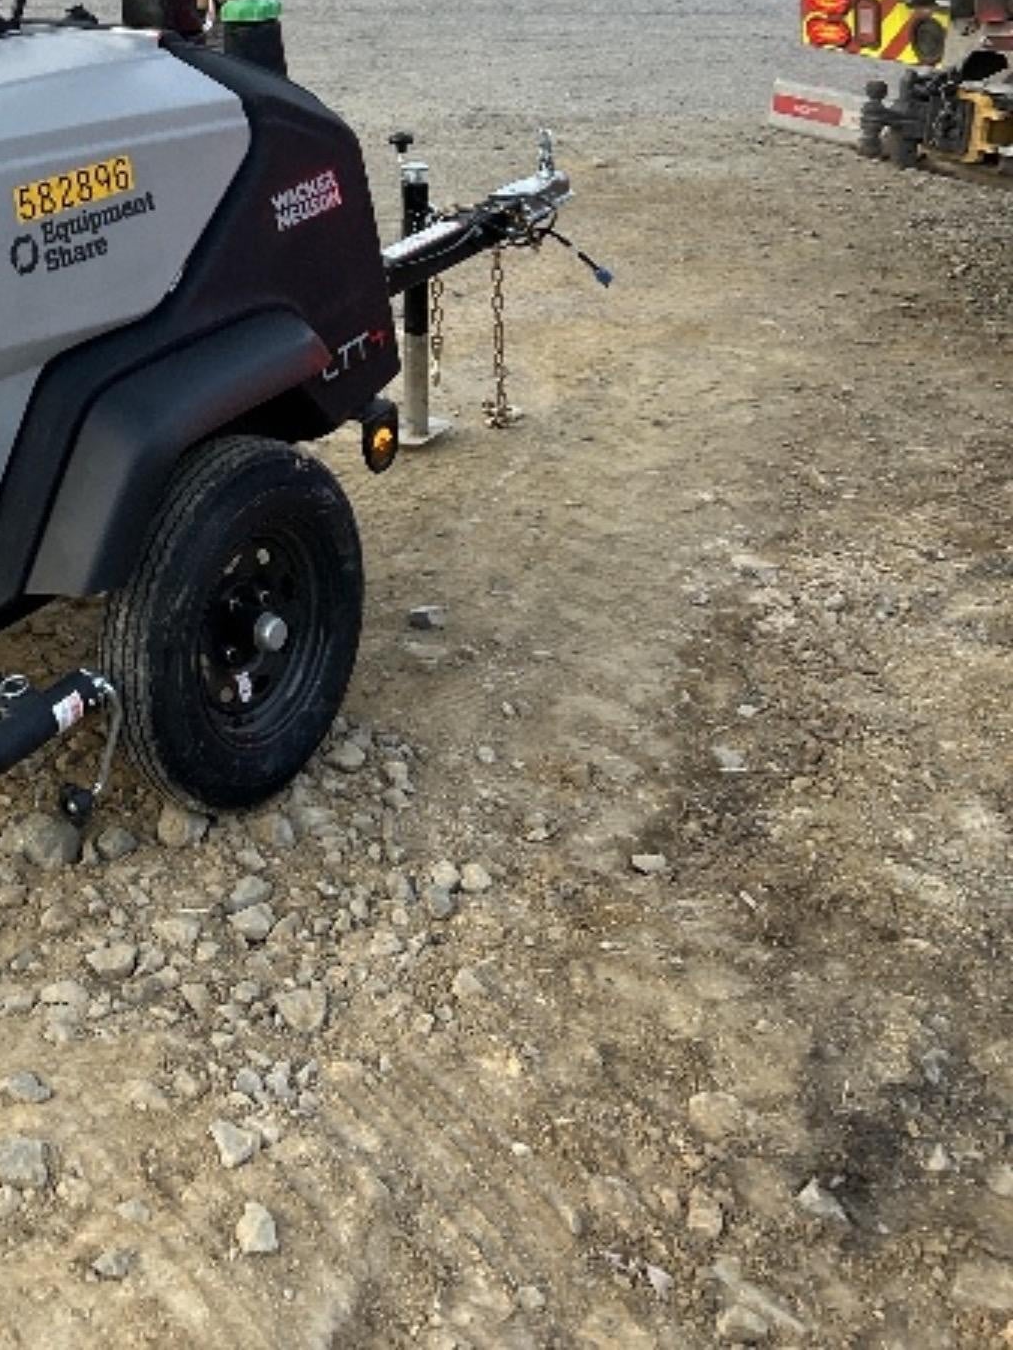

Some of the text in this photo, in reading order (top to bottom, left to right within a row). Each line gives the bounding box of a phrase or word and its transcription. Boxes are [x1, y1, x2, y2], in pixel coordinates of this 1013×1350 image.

[18, 158, 129, 221] 582896
[41, 191, 155, 244] Equipment
[44, 236, 108, 272] Share
